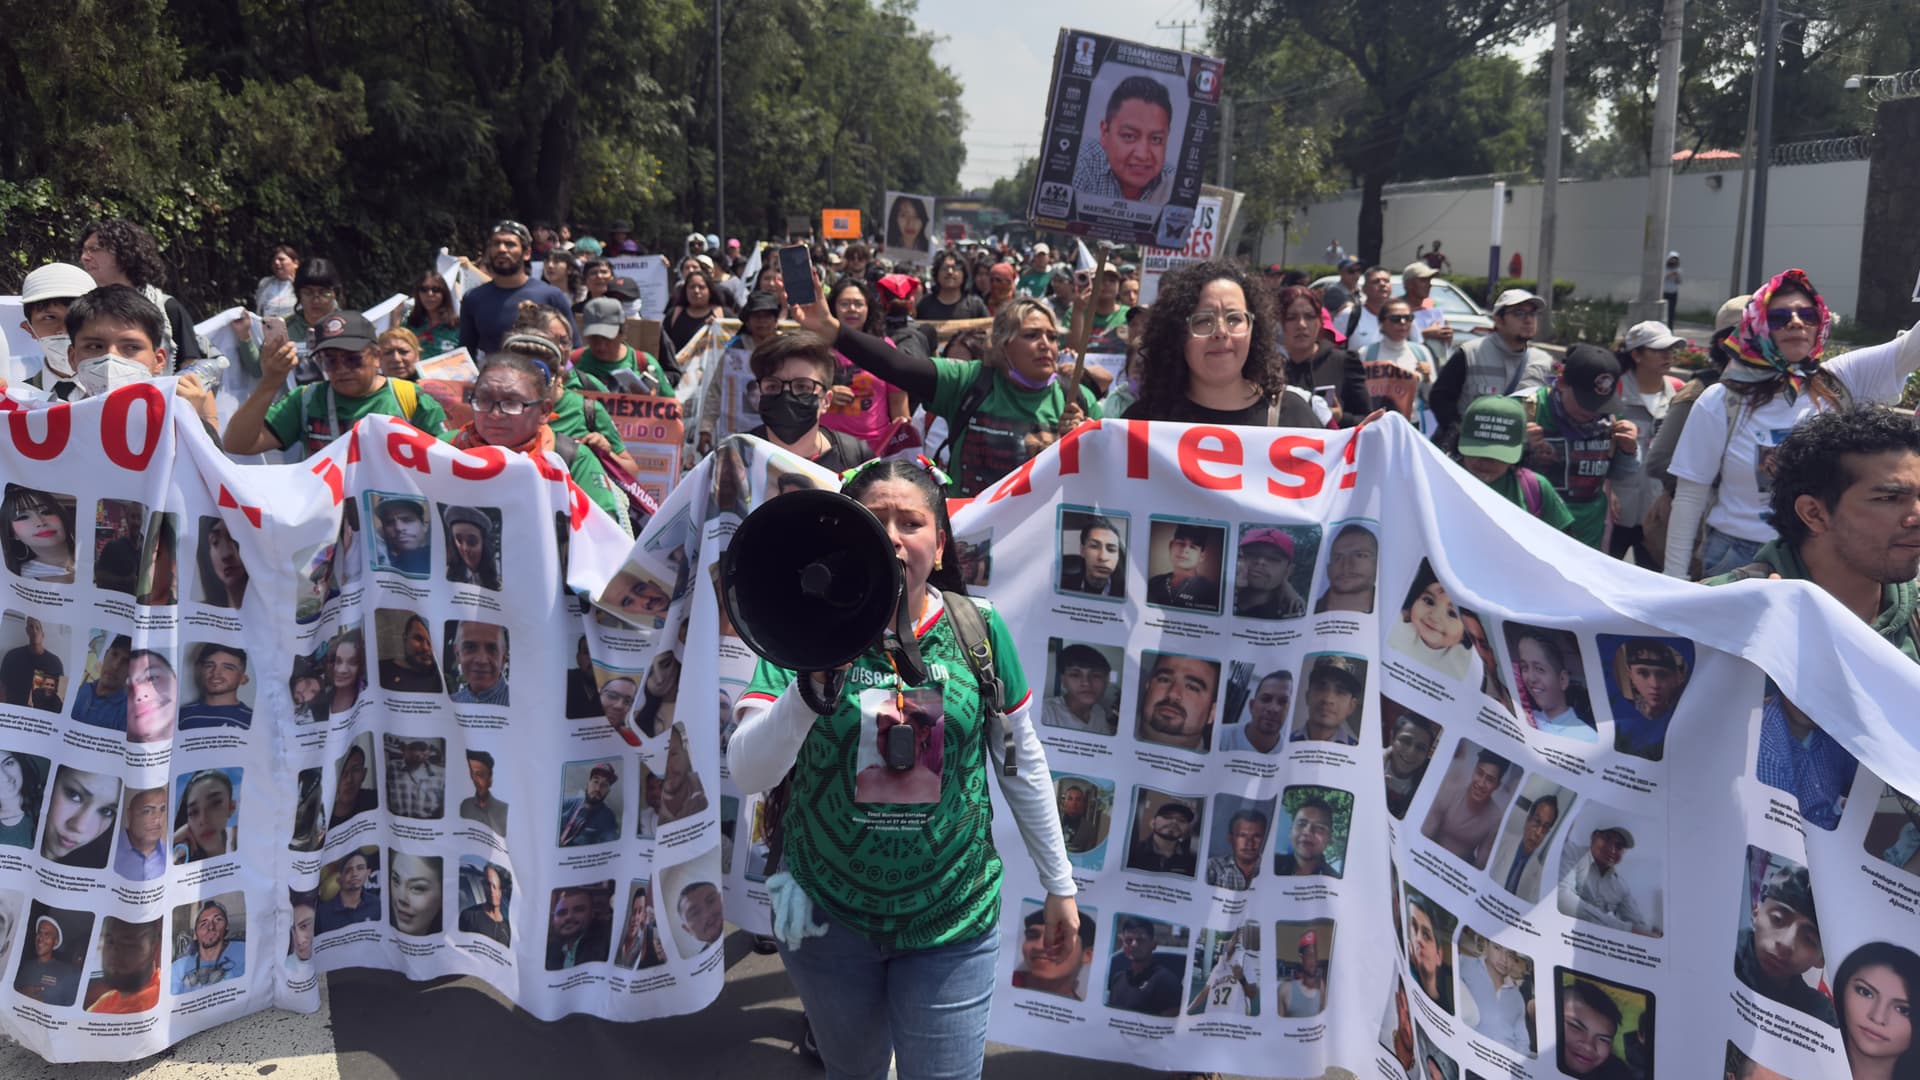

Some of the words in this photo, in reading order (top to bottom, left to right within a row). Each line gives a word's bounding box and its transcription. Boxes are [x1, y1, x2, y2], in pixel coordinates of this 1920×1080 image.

[1860, 863, 1897, 887] Guadalupe
[1871, 878, 1913, 903] Desaparece
[1888, 897, 1917, 916] Ajusco,
[1212, 986, 1233, 1006] 37
[1759, 1024, 1783, 1040] Ciudad
[1791, 1037, 1817, 1054] México
[1773, 1023, 1811, 1042] septiembre
[1791, 1019, 1826, 1040] Fernández
